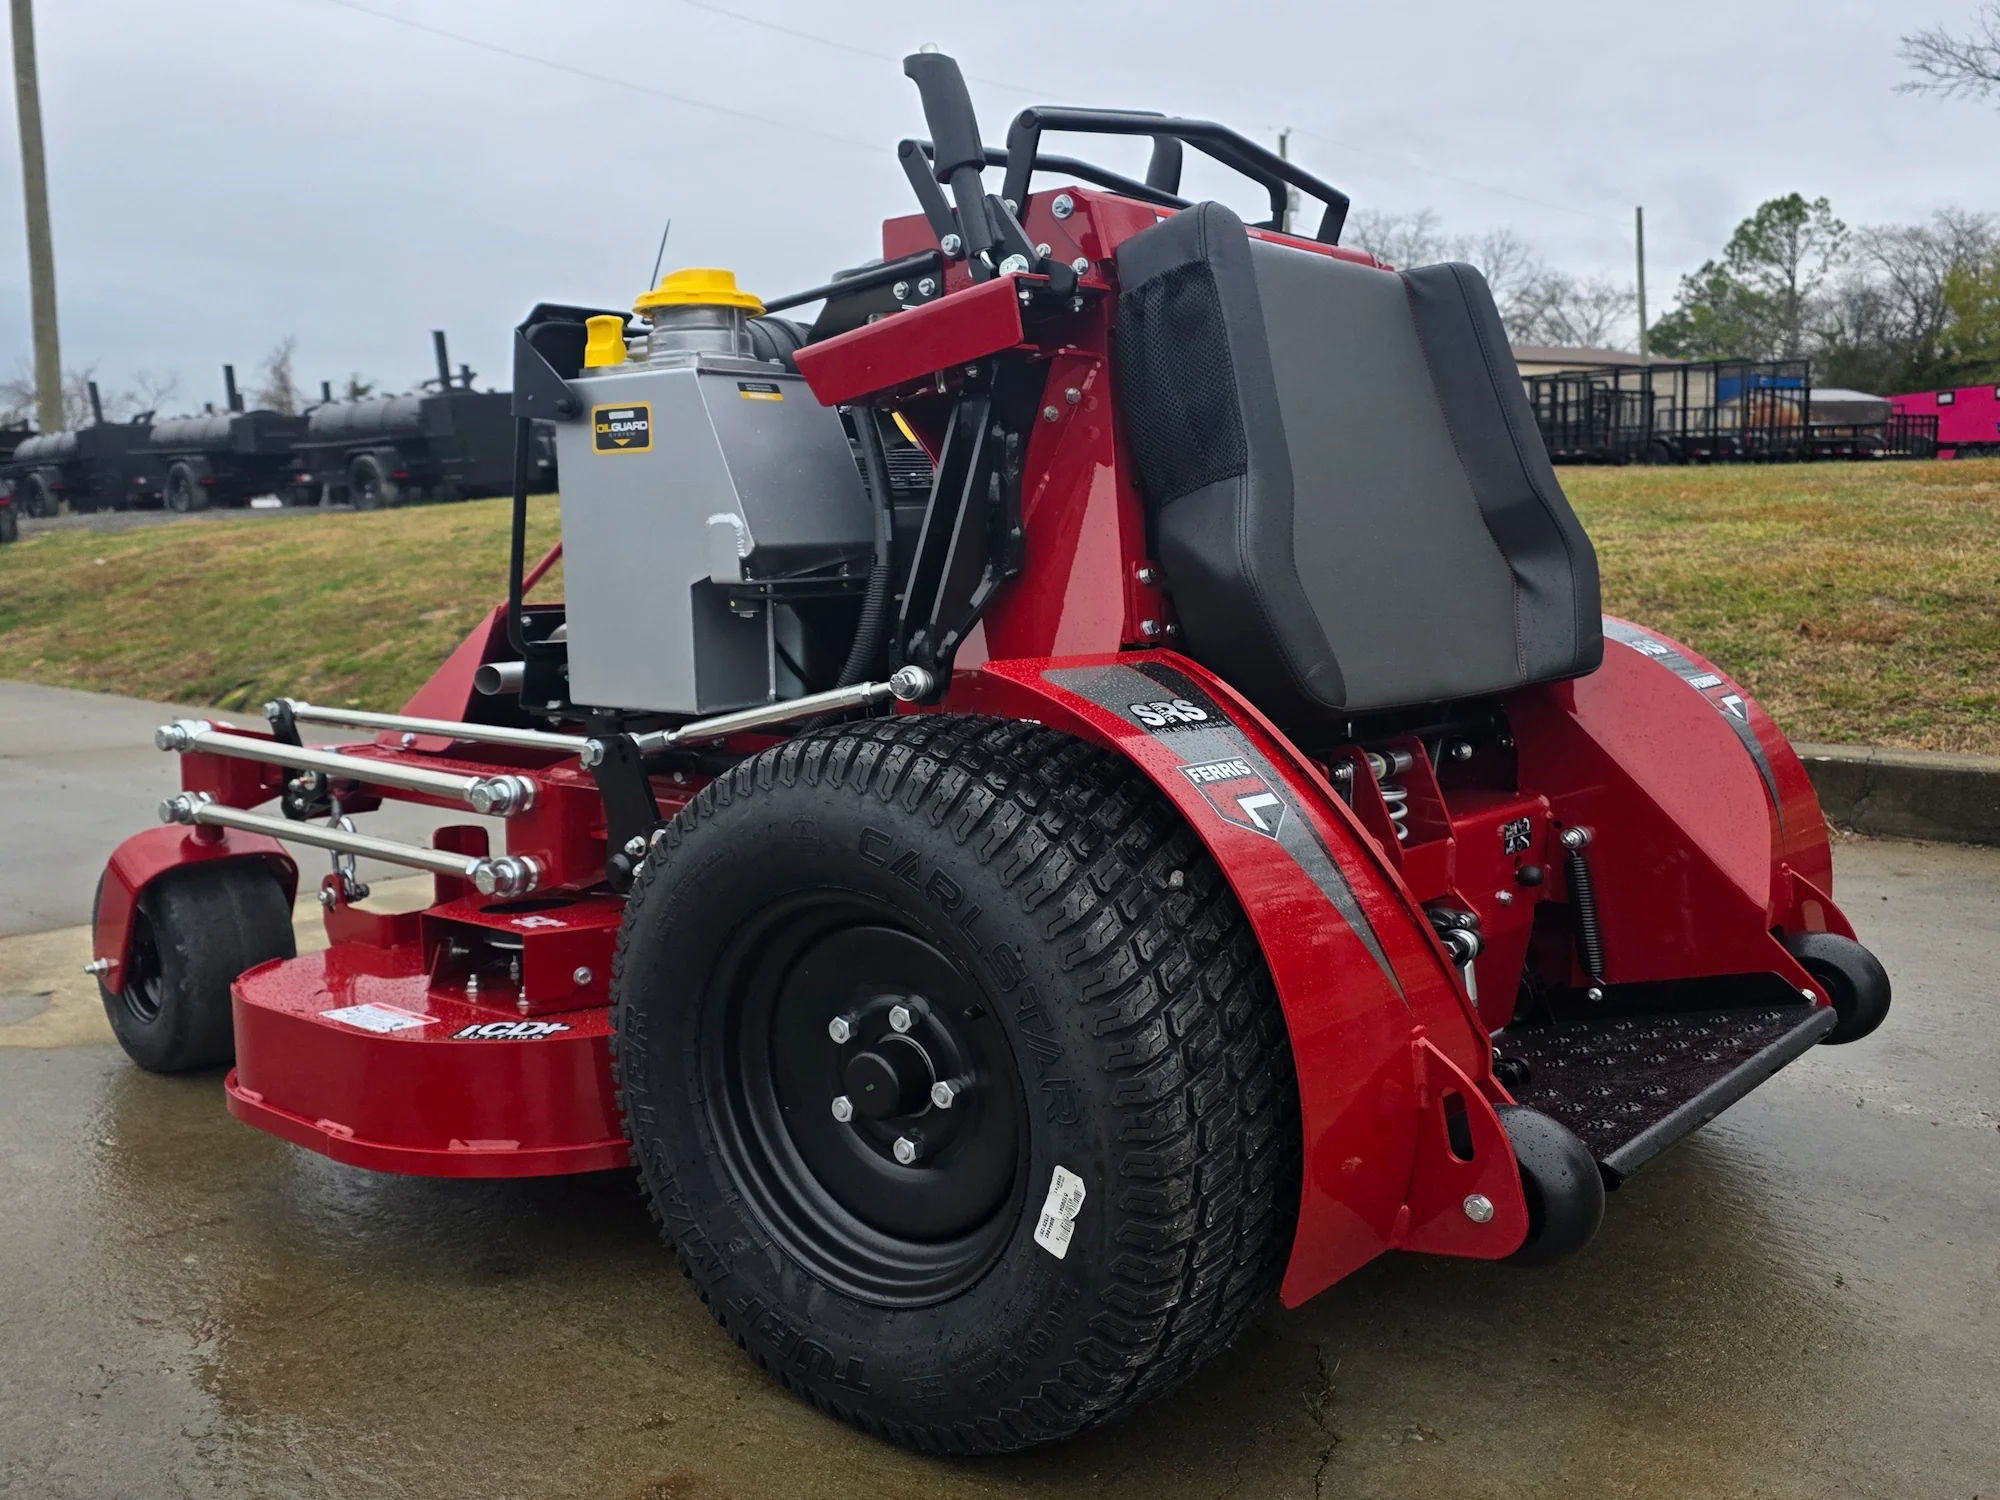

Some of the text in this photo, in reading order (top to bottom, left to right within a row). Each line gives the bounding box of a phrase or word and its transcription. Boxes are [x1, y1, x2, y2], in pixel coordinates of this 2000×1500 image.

[597, 421, 648, 433] OILGUARD
[1129, 699, 1208, 727] SRS
[1185, 758, 1252, 784] FERRIS
[858, 825, 1080, 1125] CARLSTAR
[726, 1297, 872, 1396] TURF
